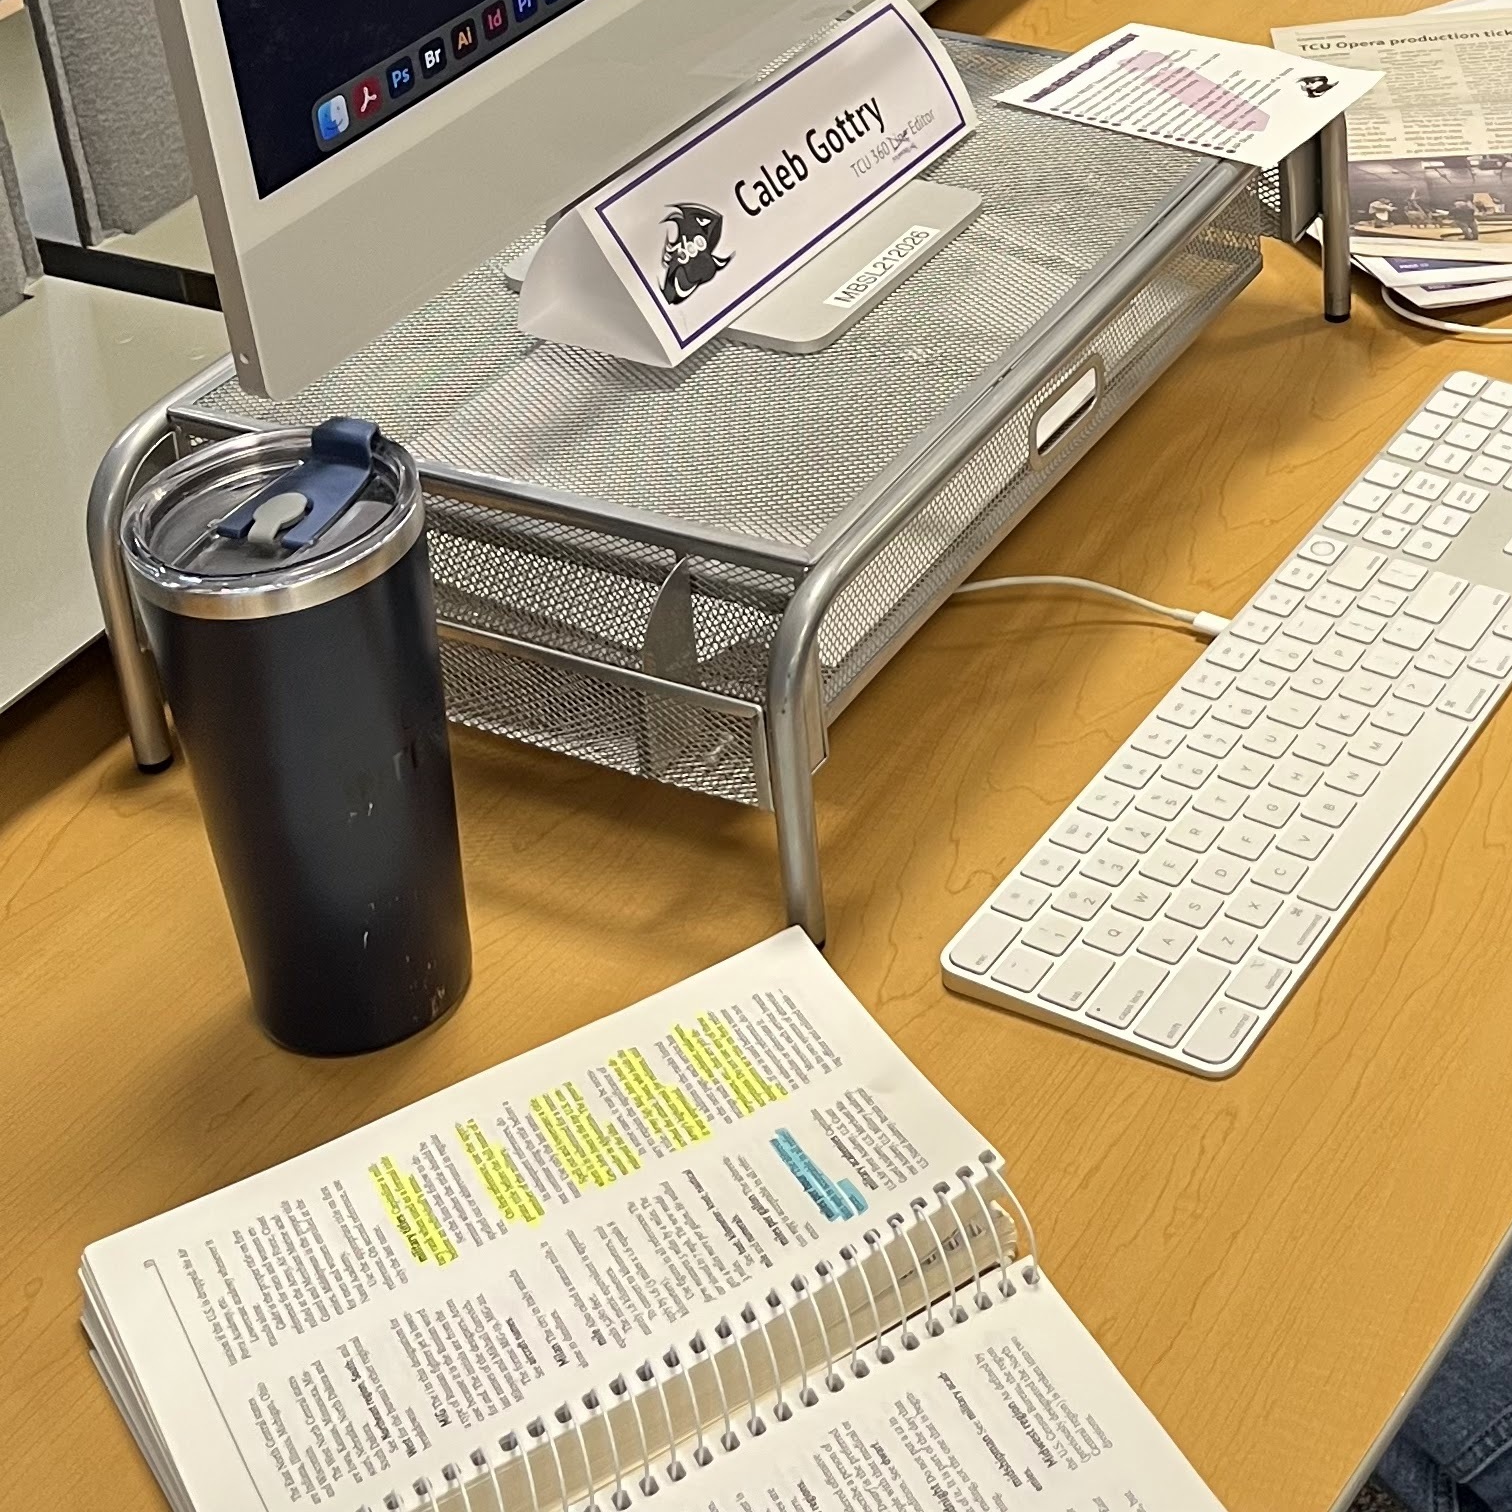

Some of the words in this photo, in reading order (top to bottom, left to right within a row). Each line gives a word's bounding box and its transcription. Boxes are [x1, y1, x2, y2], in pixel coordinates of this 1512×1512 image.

[487, 7, 502, 30] Id
[457, 26, 472, 50] Ai
[1300, 41, 1331, 53] TCU
[1335, 37, 1386, 52] Opera
[1389, 30, 1480, 48] production
[424, 48, 441, 68] Br
[391, 67, 410, 88] Ps
[850, 155, 872, 178] TCU
[870, 141, 890, 165] 360
[907, 109, 935, 135] Editor
[733, 148, 810, 217] Caleb
[804, 95, 885, 166] Gottry
[833, 227, 932, 304] MBSL212026
[380, 1182, 401, 1214] Capitalize
[747, 1193, 769, 1215] gallon
[396, 1213, 411, 1234] titles
[762, 1214, 778, 1228] per
[406, 1232, 427, 1262] military
[771, 1226, 789, 1246] miles
[551, 1342, 569, 1367] Milan
[974, 1352, 985, 1365] by
[986, 1346, 1007, 1371] region
[937, 1371, 956, 1390] acad-
[978, 1362, 1004, 1390] defined
[1003, 1370, 1016, 1384] the
[952, 1390, 976, 1420] military
[1000, 1389, 1011, 1401] As
[1014, 1382, 1036, 1414] Bureau,
[1007, 1400, 1031, 1429] region
[1033, 1411, 1056, 1441] Census
[973, 1419, 986, 1435] See
[1025, 1427, 1057, 1468] Midwest
[1052, 1439, 1068, 1458] U.S.
[982, 1434, 1022, 1487] midshipman
[1064, 1456, 1078, 1471] the
